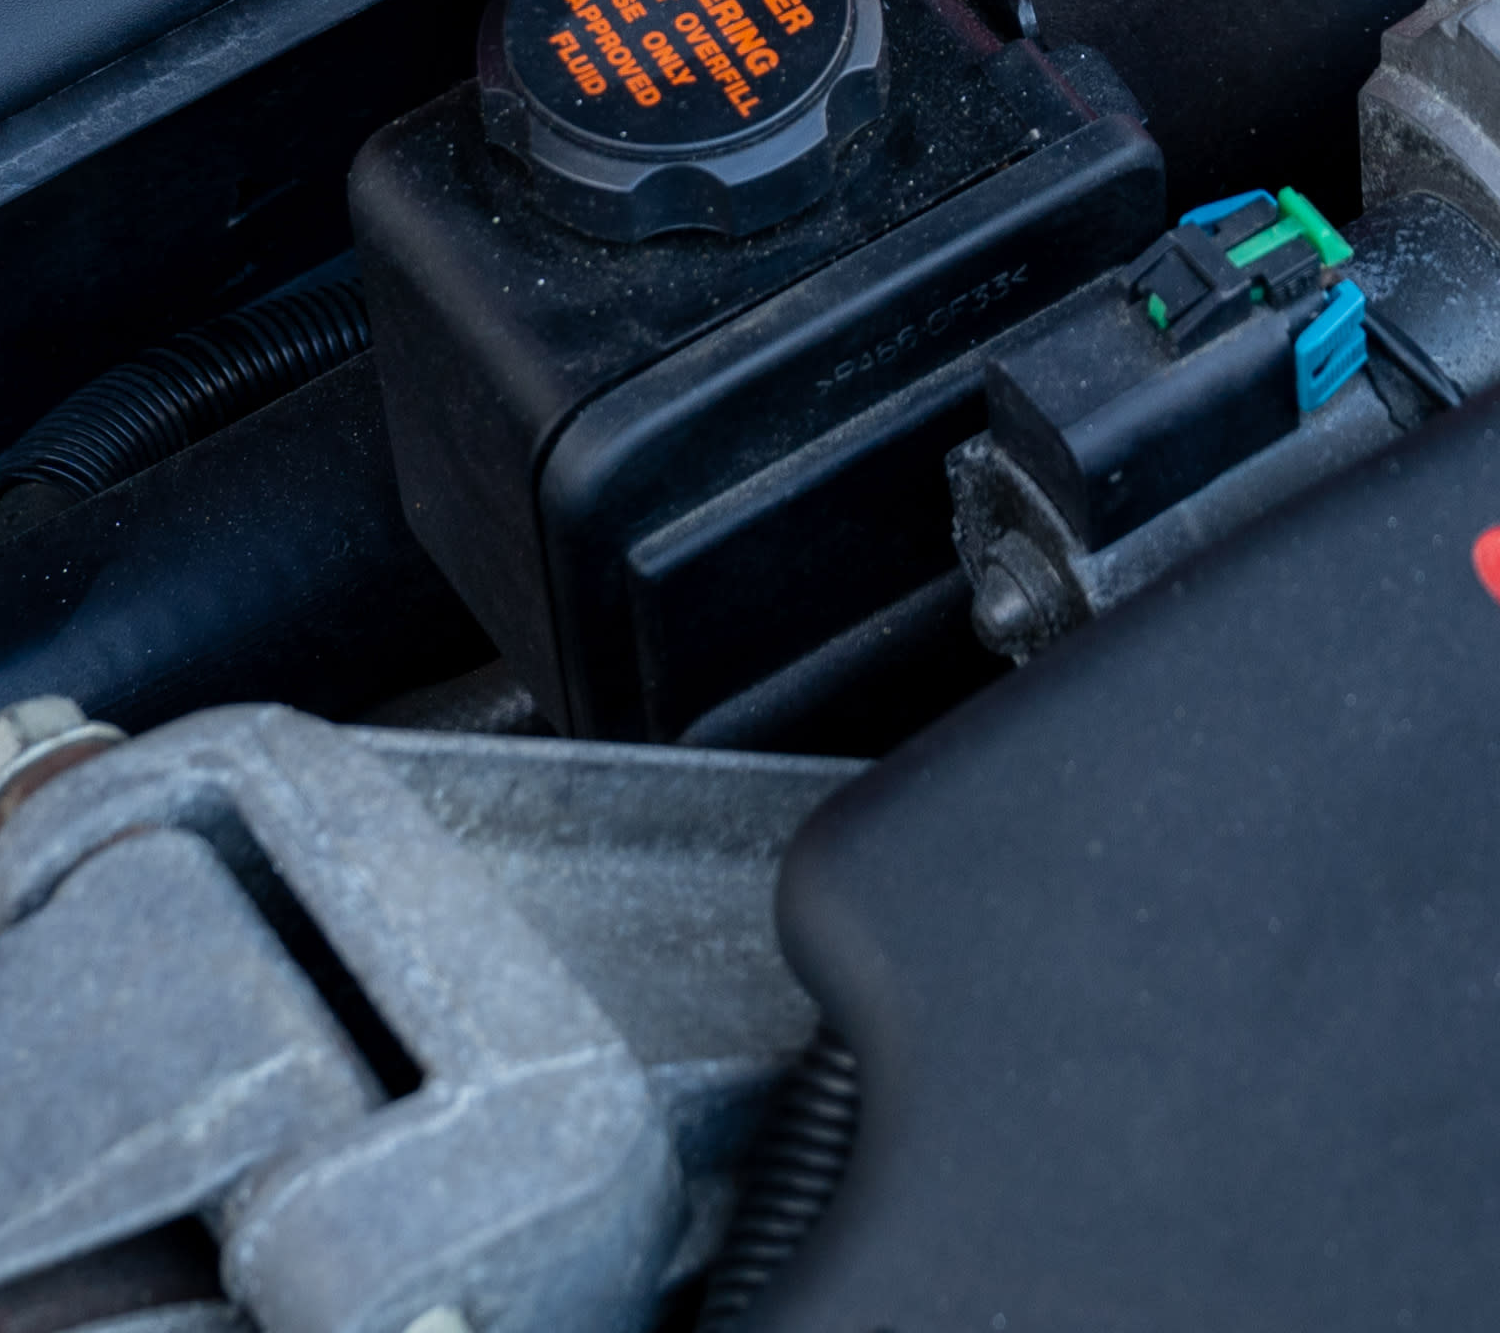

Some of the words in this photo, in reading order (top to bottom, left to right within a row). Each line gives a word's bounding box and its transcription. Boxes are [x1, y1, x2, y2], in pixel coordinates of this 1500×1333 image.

[549, 29, 609, 97] FLUID
[641, 30, 697, 87] ONLY
[674, 11, 763, 120] OVERFILL
